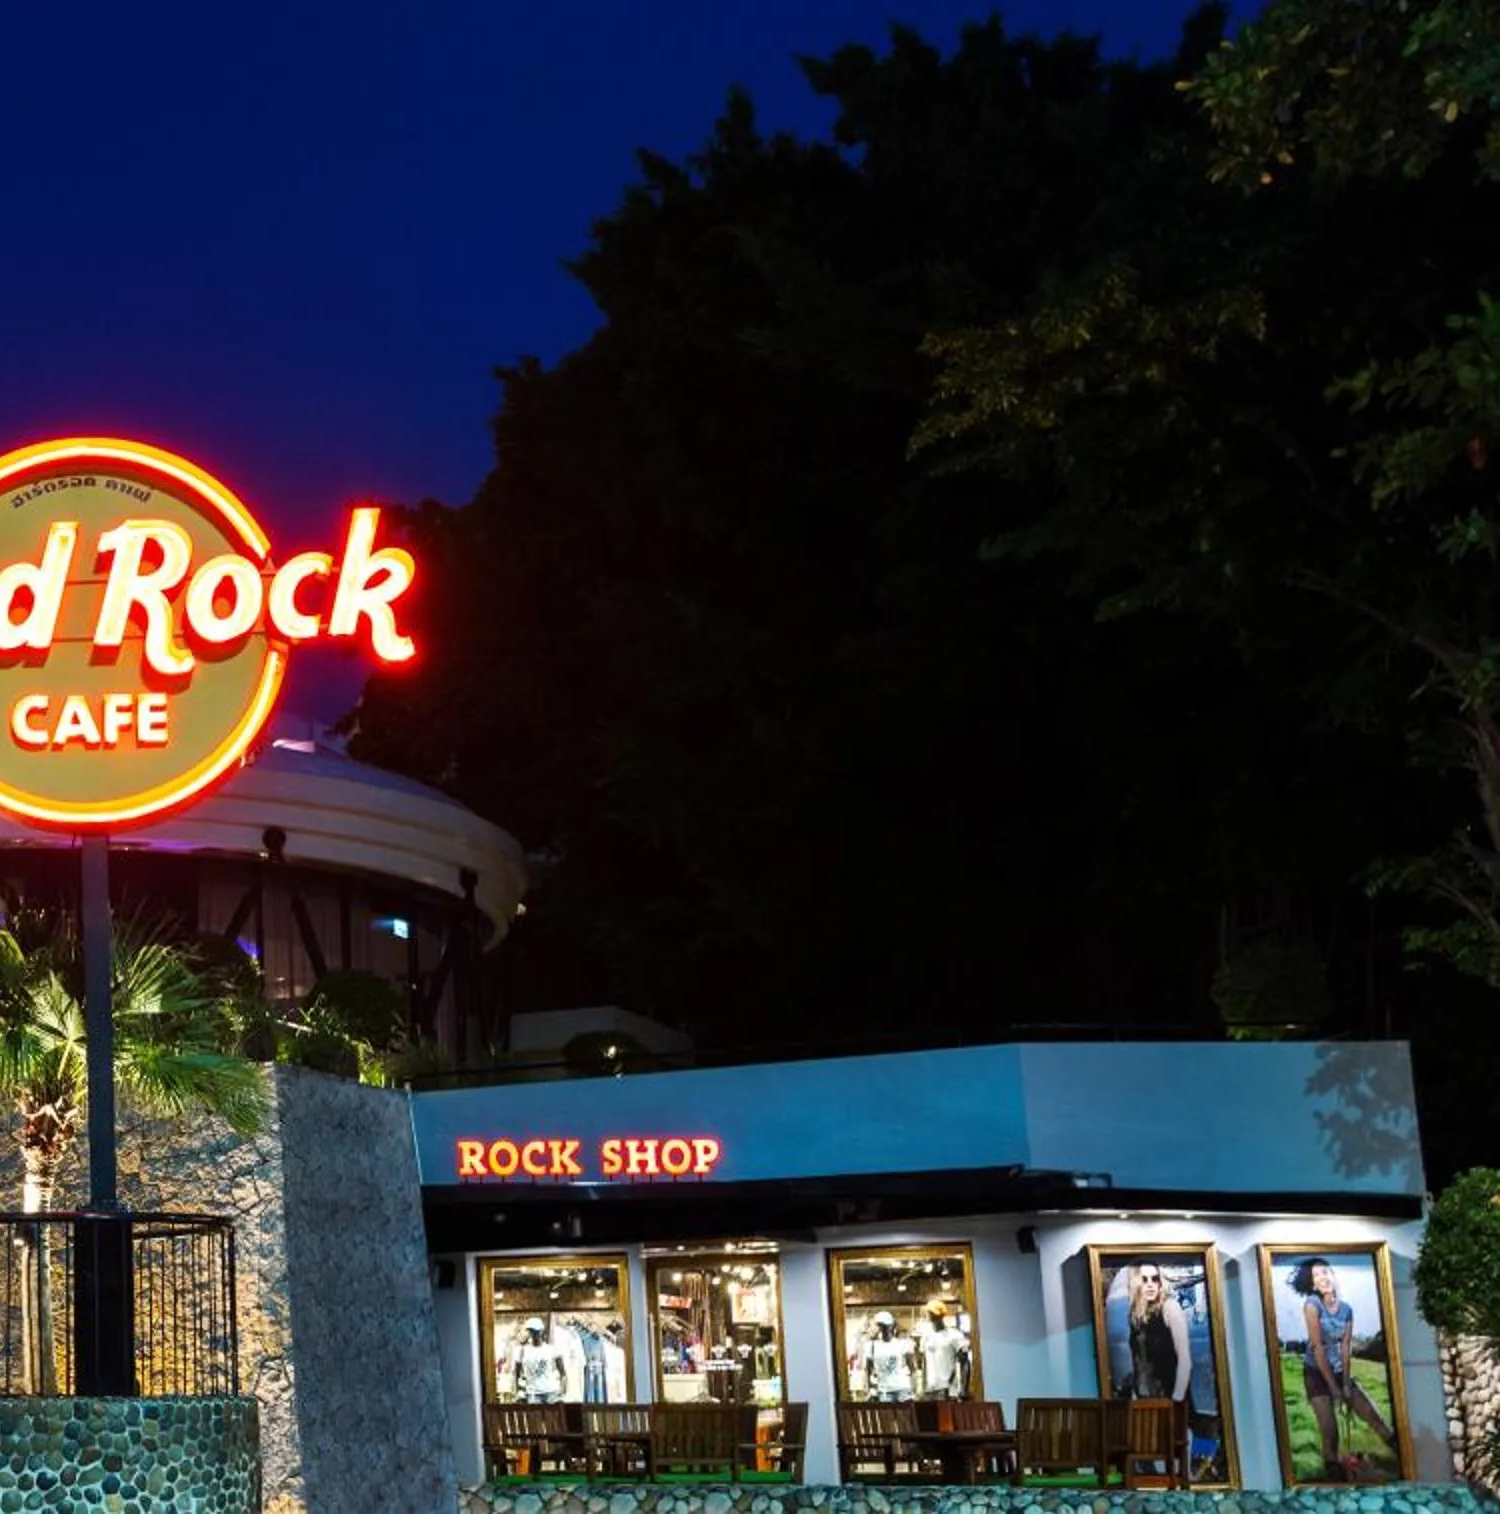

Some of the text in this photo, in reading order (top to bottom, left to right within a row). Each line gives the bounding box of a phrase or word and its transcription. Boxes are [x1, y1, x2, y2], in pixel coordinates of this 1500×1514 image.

[95, 506, 417, 678] Rock
[12, 692, 169, 747] CAFE
[457, 1138, 720, 1176] ROCK SHOP
